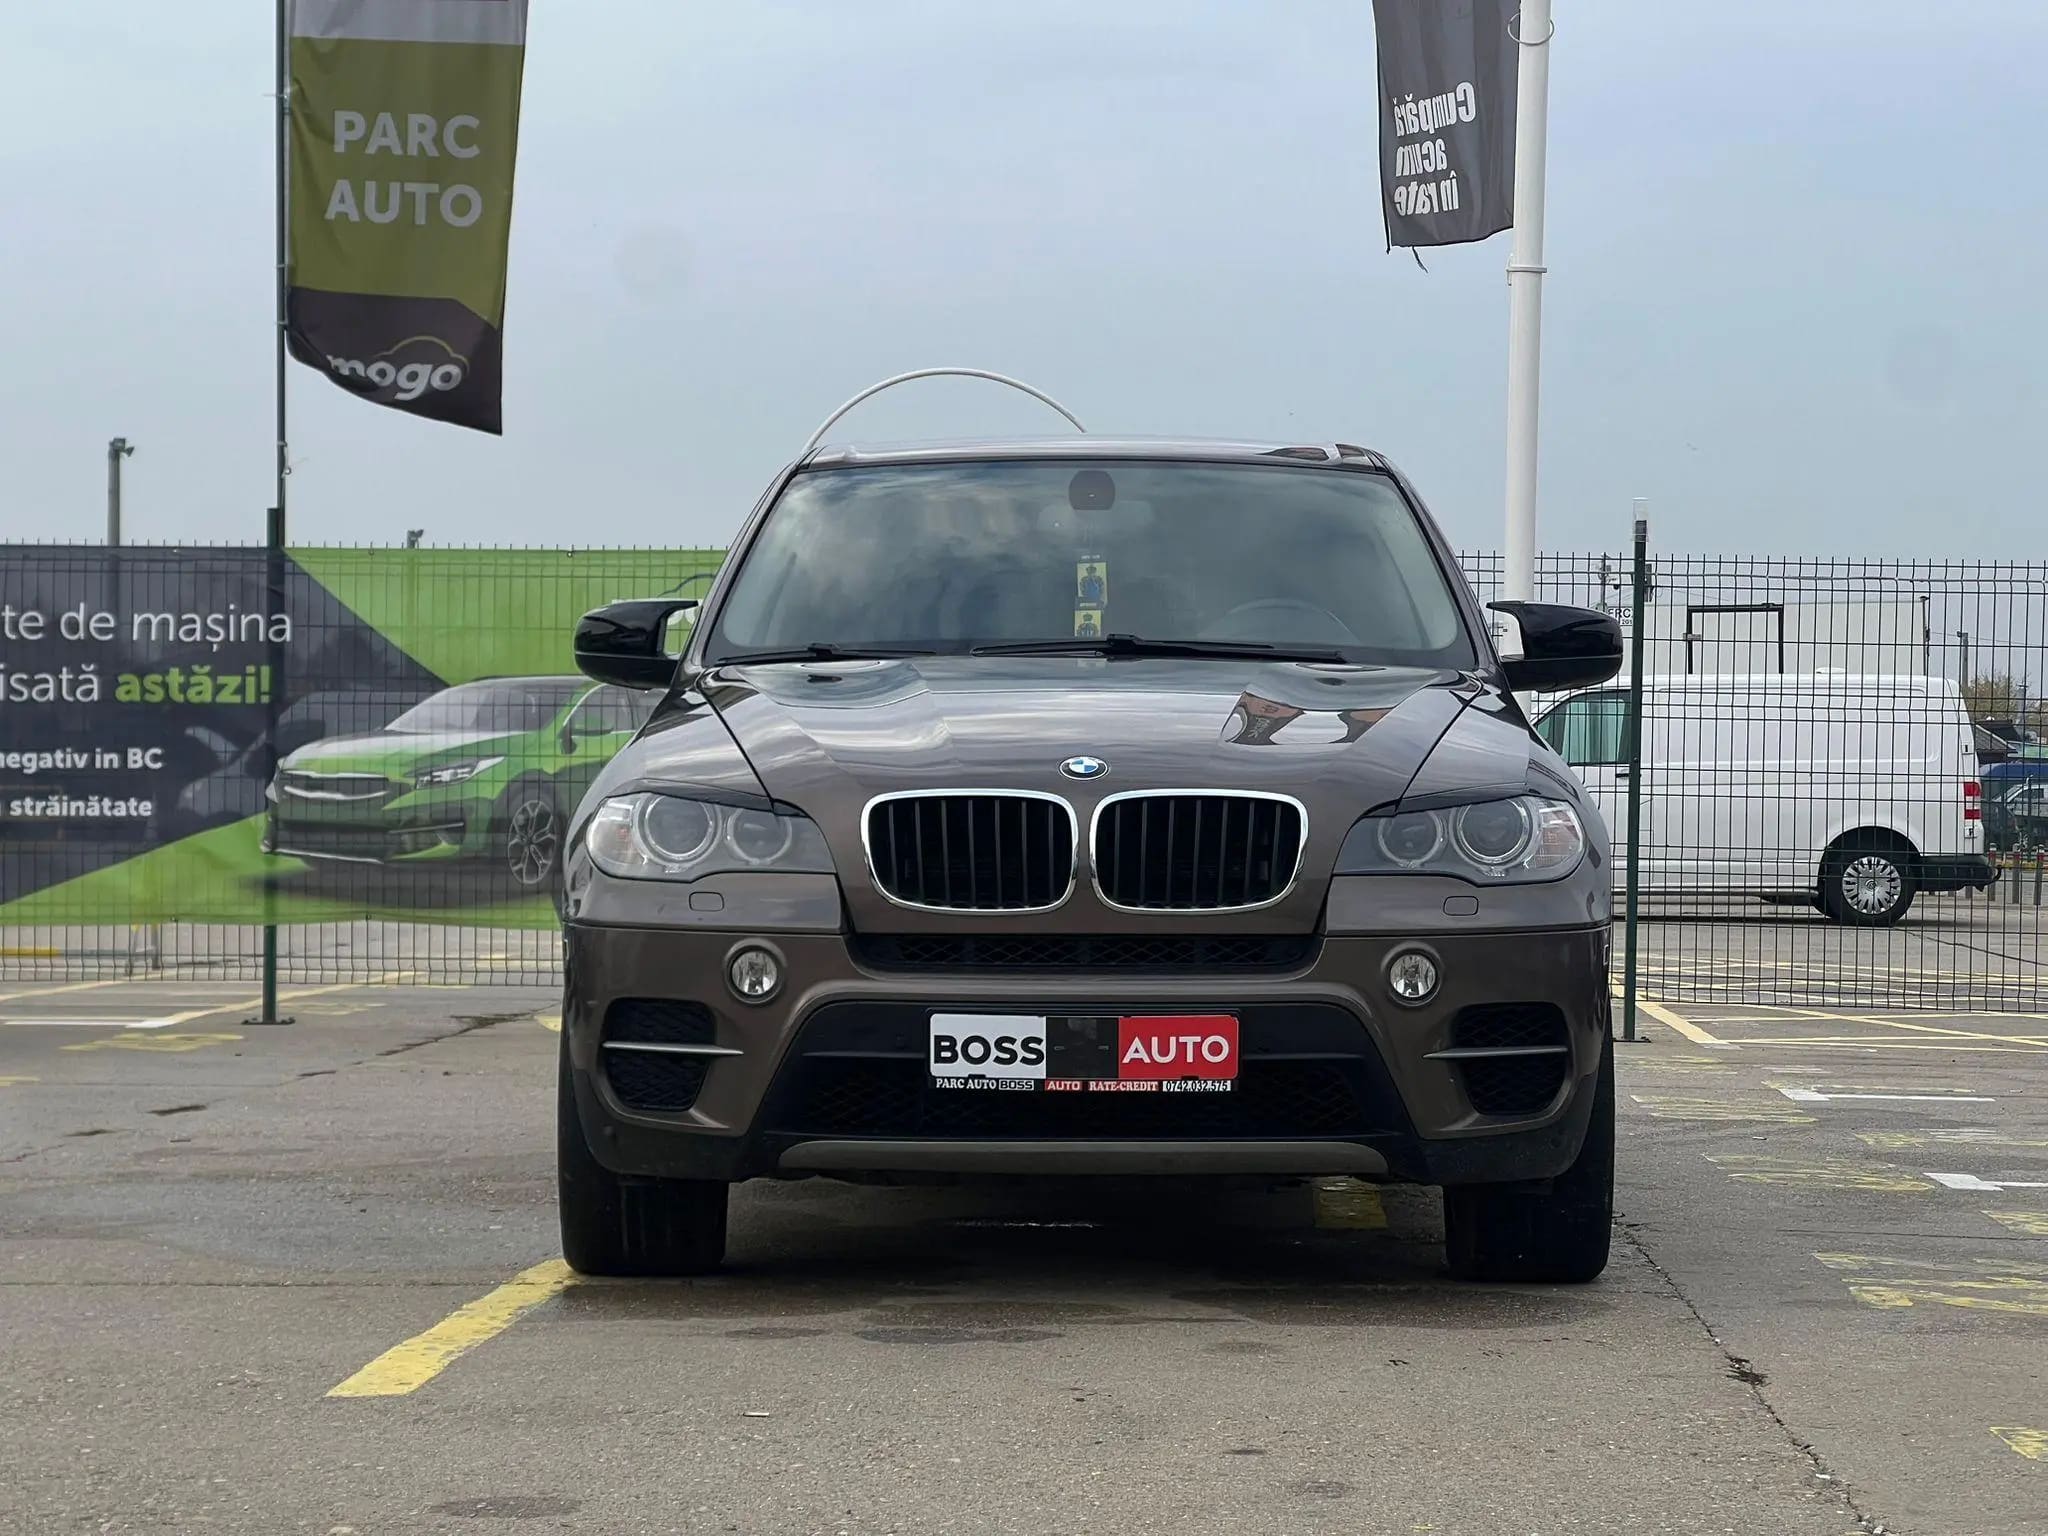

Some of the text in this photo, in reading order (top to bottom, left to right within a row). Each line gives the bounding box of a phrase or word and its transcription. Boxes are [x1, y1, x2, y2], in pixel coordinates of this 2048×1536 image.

[333, 110, 481, 159] PARC
[324, 179, 482, 228] AUTO
[326, 354, 463, 401] mogo
[59, 602, 115, 641] de
[132, 603, 292, 652] mașina
[115, 664, 273, 704] astăzi!
[95, 748, 119, 769] in
[127, 748, 165, 769] BC
[9, 795, 153, 817] străinătate
[933, 1035, 1045, 1065] BOSS
[1122, 1035, 1230, 1064] AUTO
[936, 1077, 965, 1089] PARC
[966, 1079, 997, 1090] AUTO
[1000, 1080, 1034, 1091] BOSS
[1047, 1080, 1081, 1092] AUTO
[1088, 1080, 1159, 1092] RATE-CREDIT
